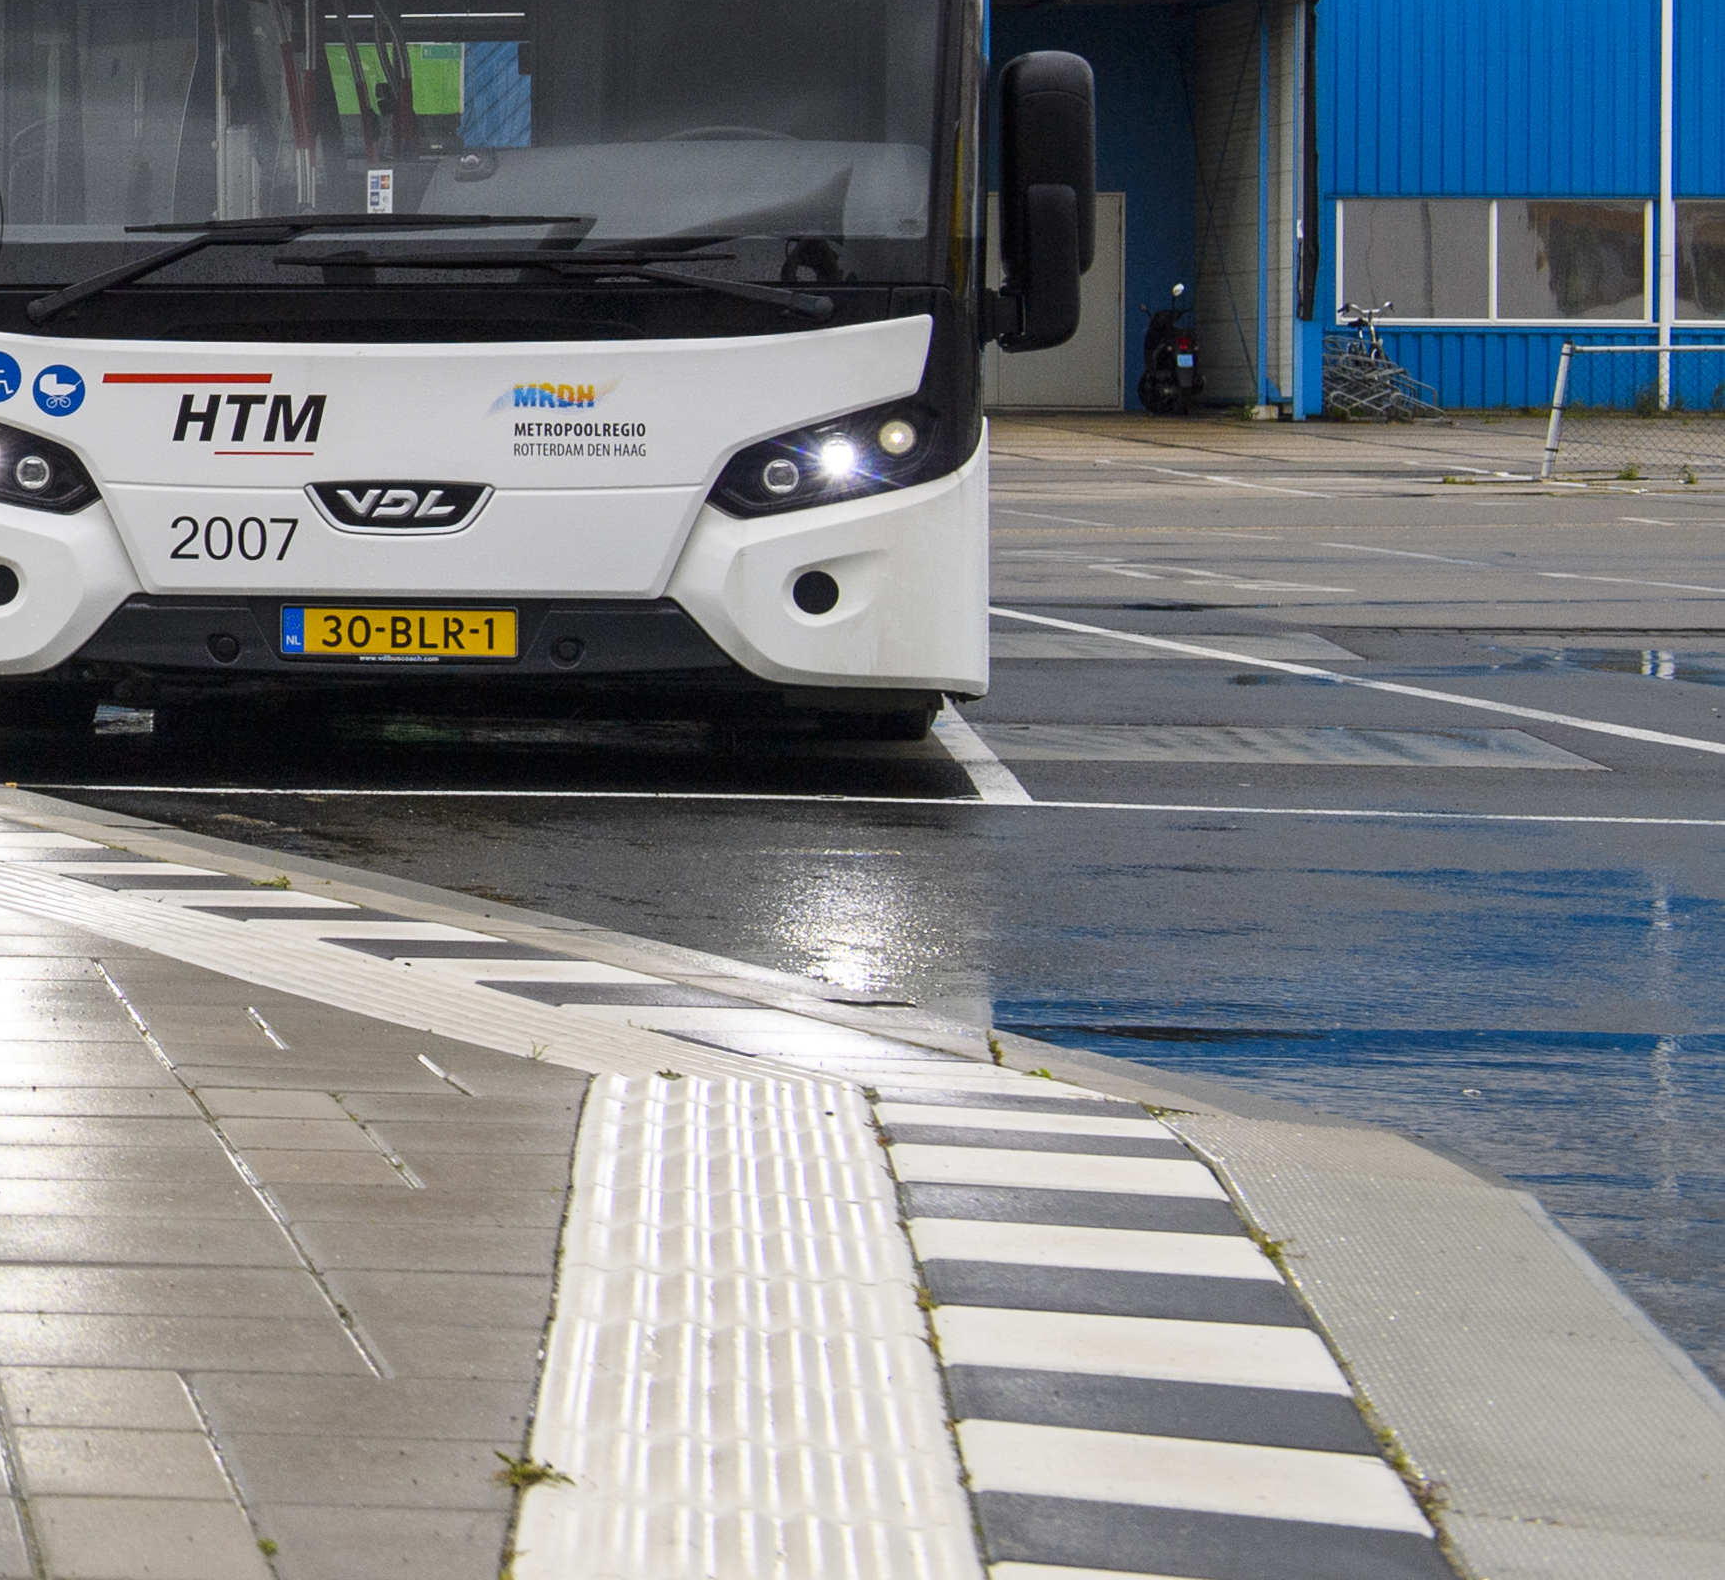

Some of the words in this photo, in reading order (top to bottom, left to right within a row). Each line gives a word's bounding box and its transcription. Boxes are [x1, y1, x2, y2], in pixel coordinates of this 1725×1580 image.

[513, 382, 595, 408] MRDH
[172, 394, 327, 442] HTM
[514, 423, 646, 437] METROPOOLREGIO
[513, 443, 585, 457] ROTTERDAM
[587, 443, 611, 457] DEN
[613, 443, 647, 457] HAAG
[336, 489, 456, 518] VDL
[169, 516, 299, 561] 2007
[286, 635, 301, 645] NL
[321, 615, 494, 650] 30-BLR-1
